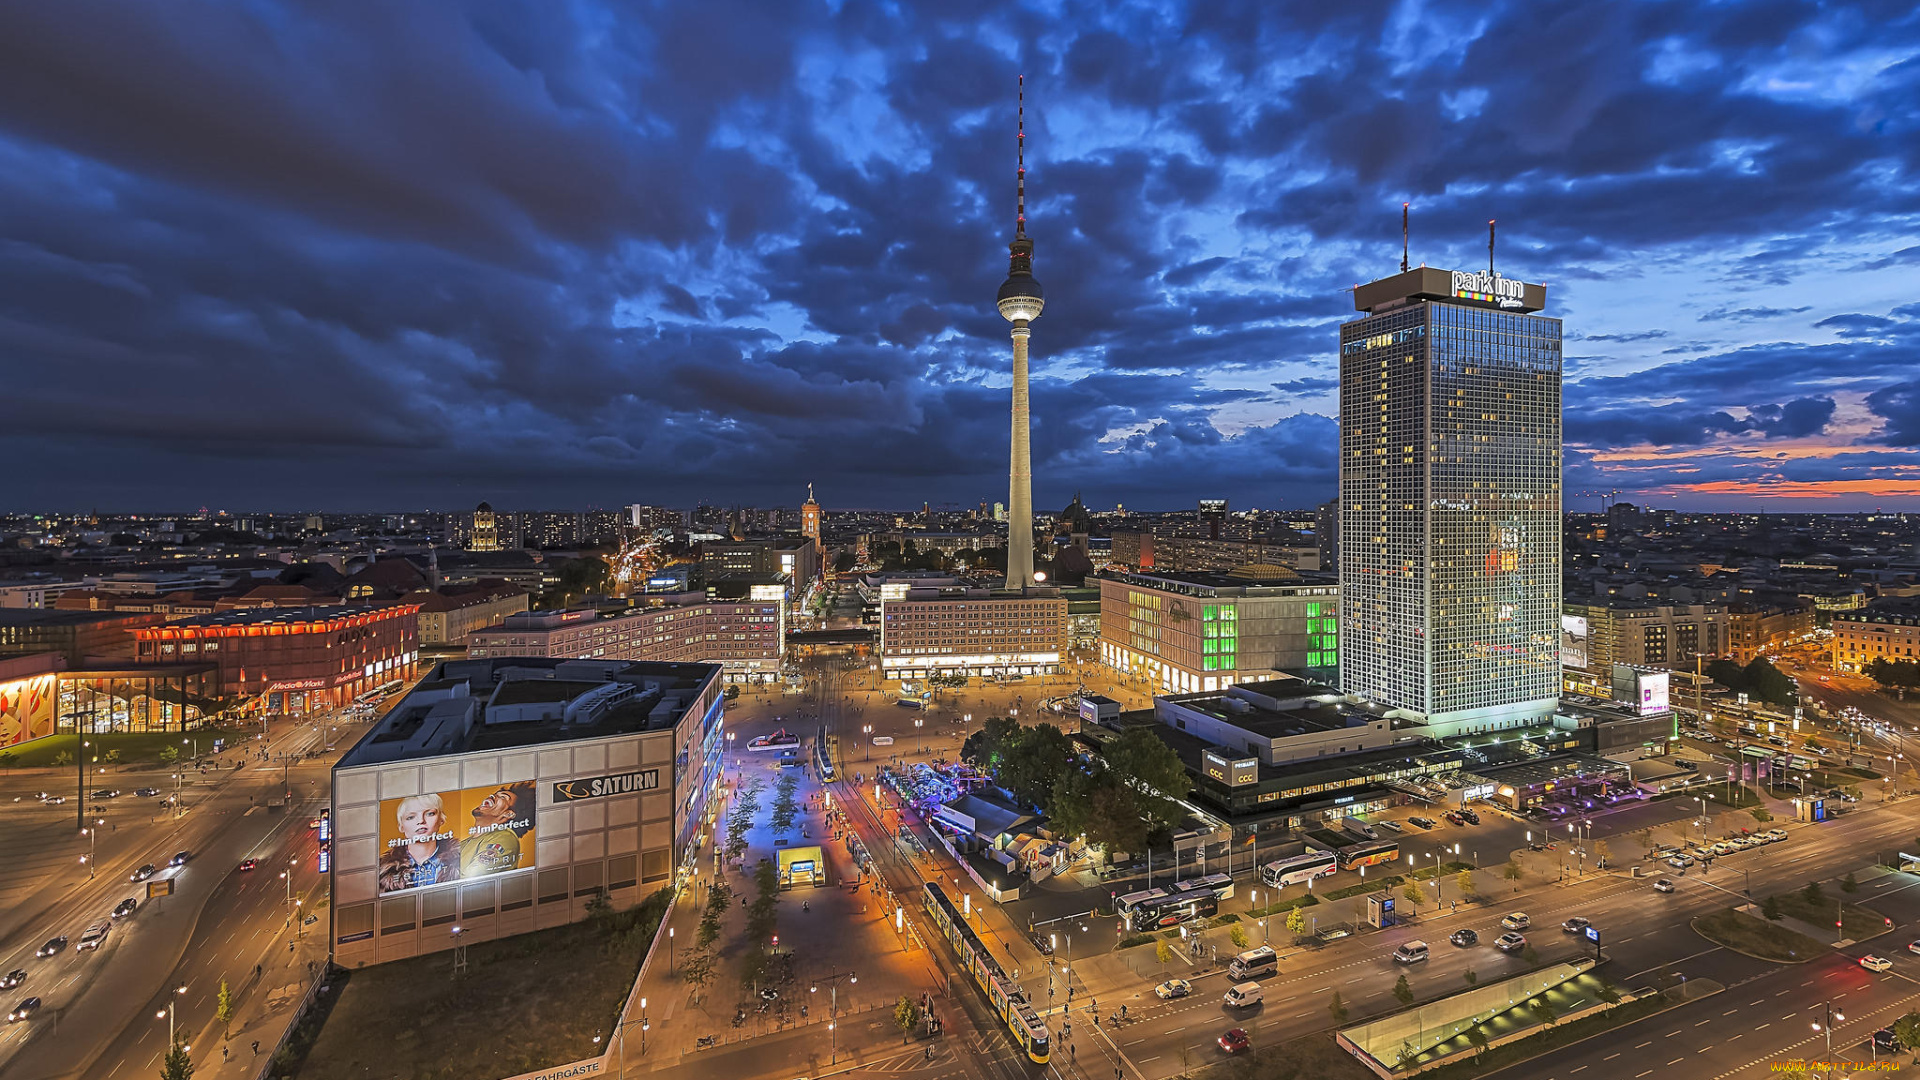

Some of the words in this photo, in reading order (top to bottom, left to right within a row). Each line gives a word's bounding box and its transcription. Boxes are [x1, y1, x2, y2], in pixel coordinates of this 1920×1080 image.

[1451, 269, 1494, 297] park
[1495, 272, 1524, 298] inn
[1209, 768, 1224, 780] CCC
[1238, 774, 1253, 783] CCC
[591, 771, 656, 796] SATURN
[468, 818, 530, 835] #ImPerfect
[388, 830, 454, 848] #ImPerfect
